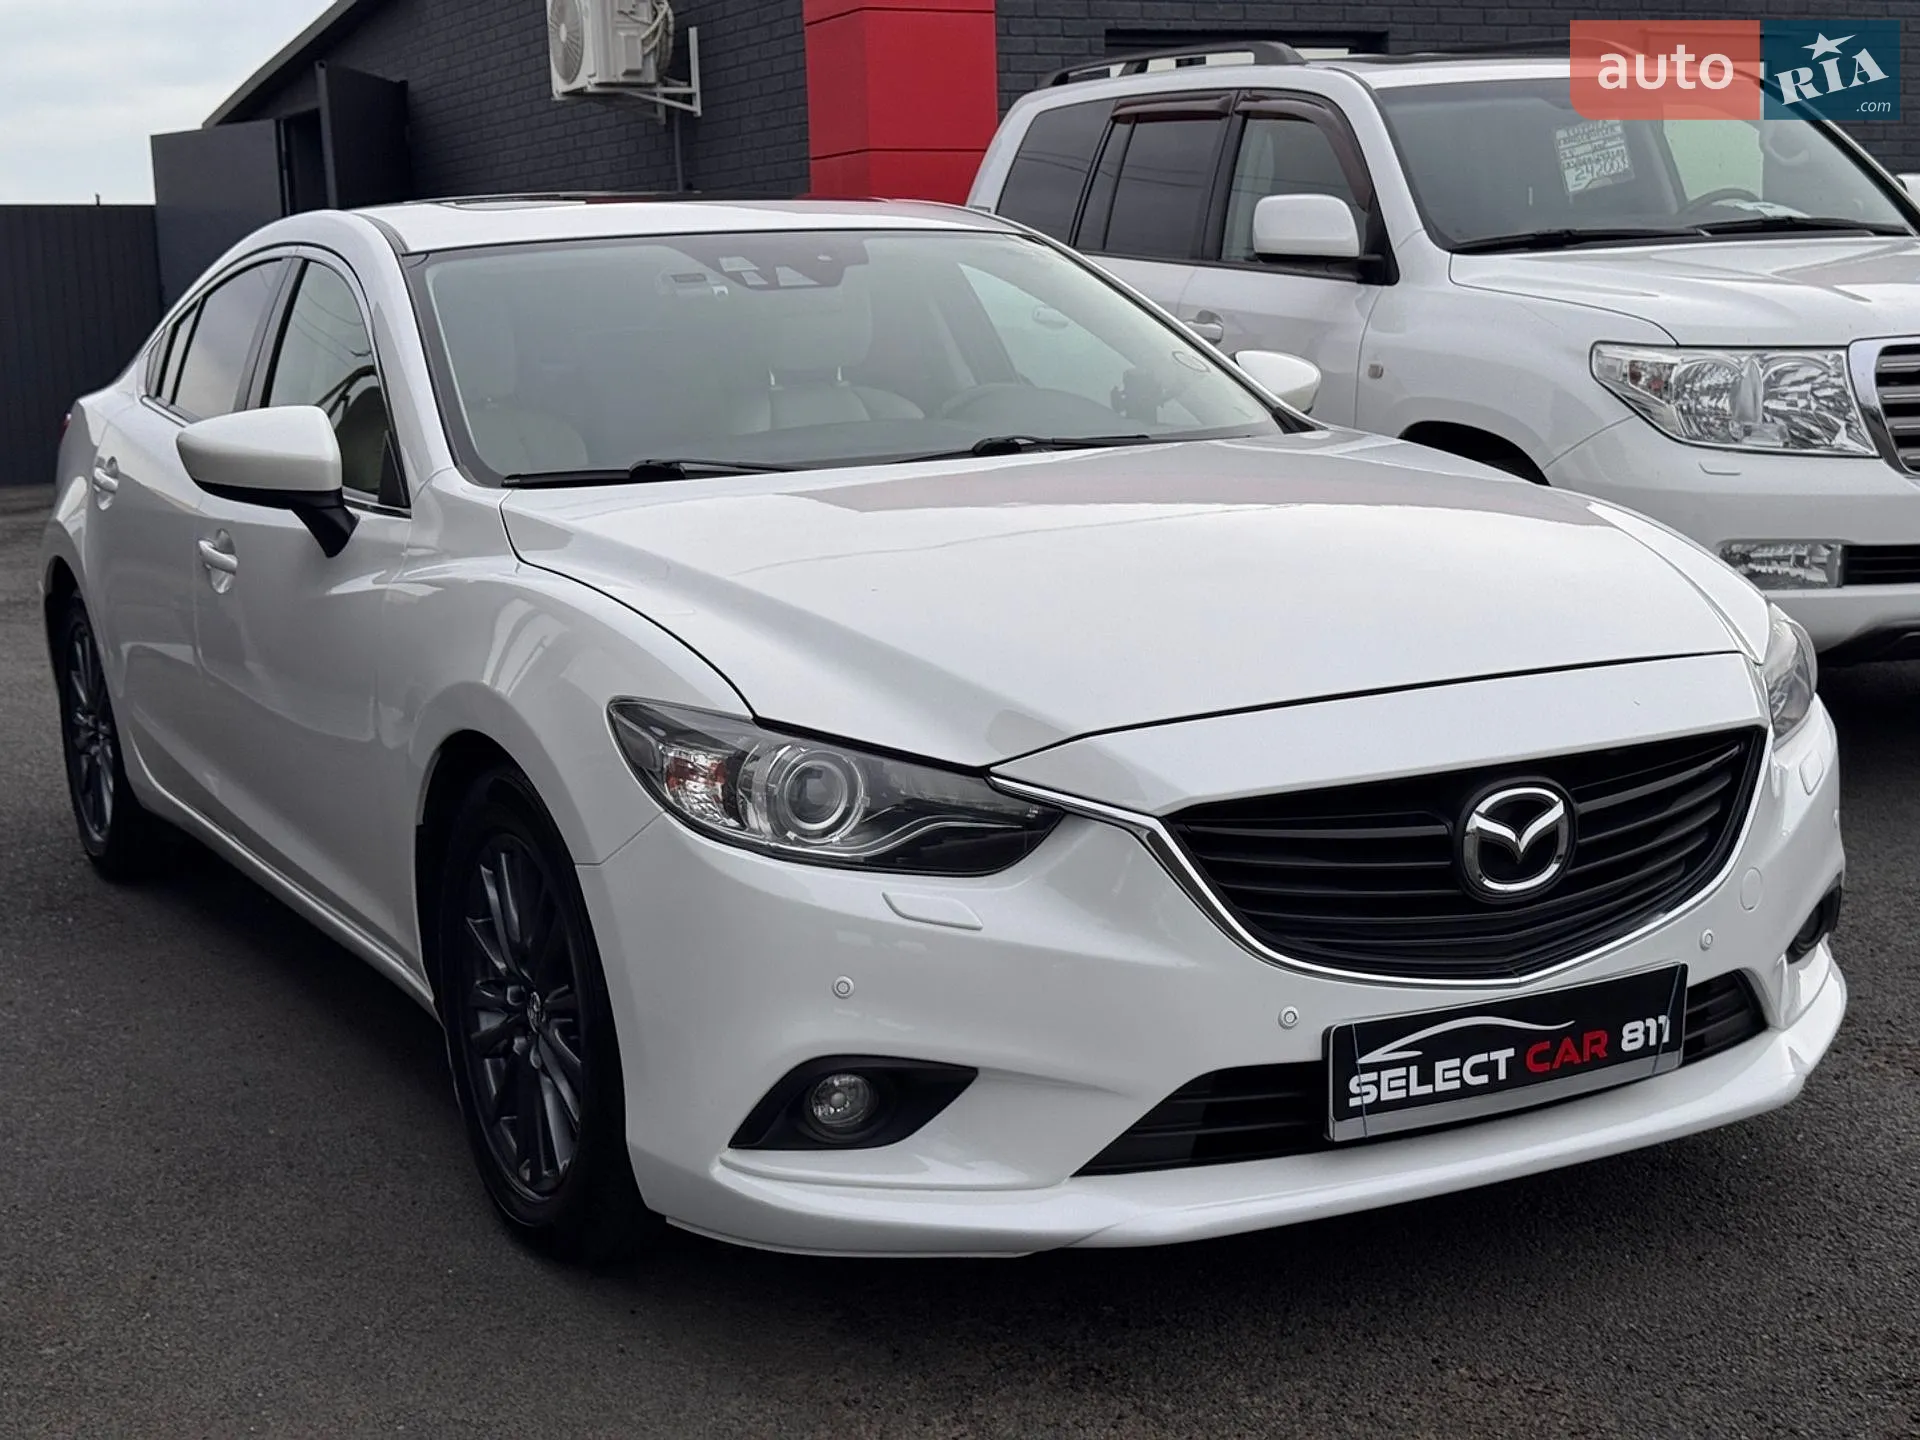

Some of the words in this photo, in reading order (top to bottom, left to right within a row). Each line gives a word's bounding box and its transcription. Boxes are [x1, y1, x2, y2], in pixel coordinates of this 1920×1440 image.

[1349, 1048, 1515, 1108] SELECT
[1526, 1031, 1608, 1073] CAR
[1621, 1014, 1670, 1052] 811
